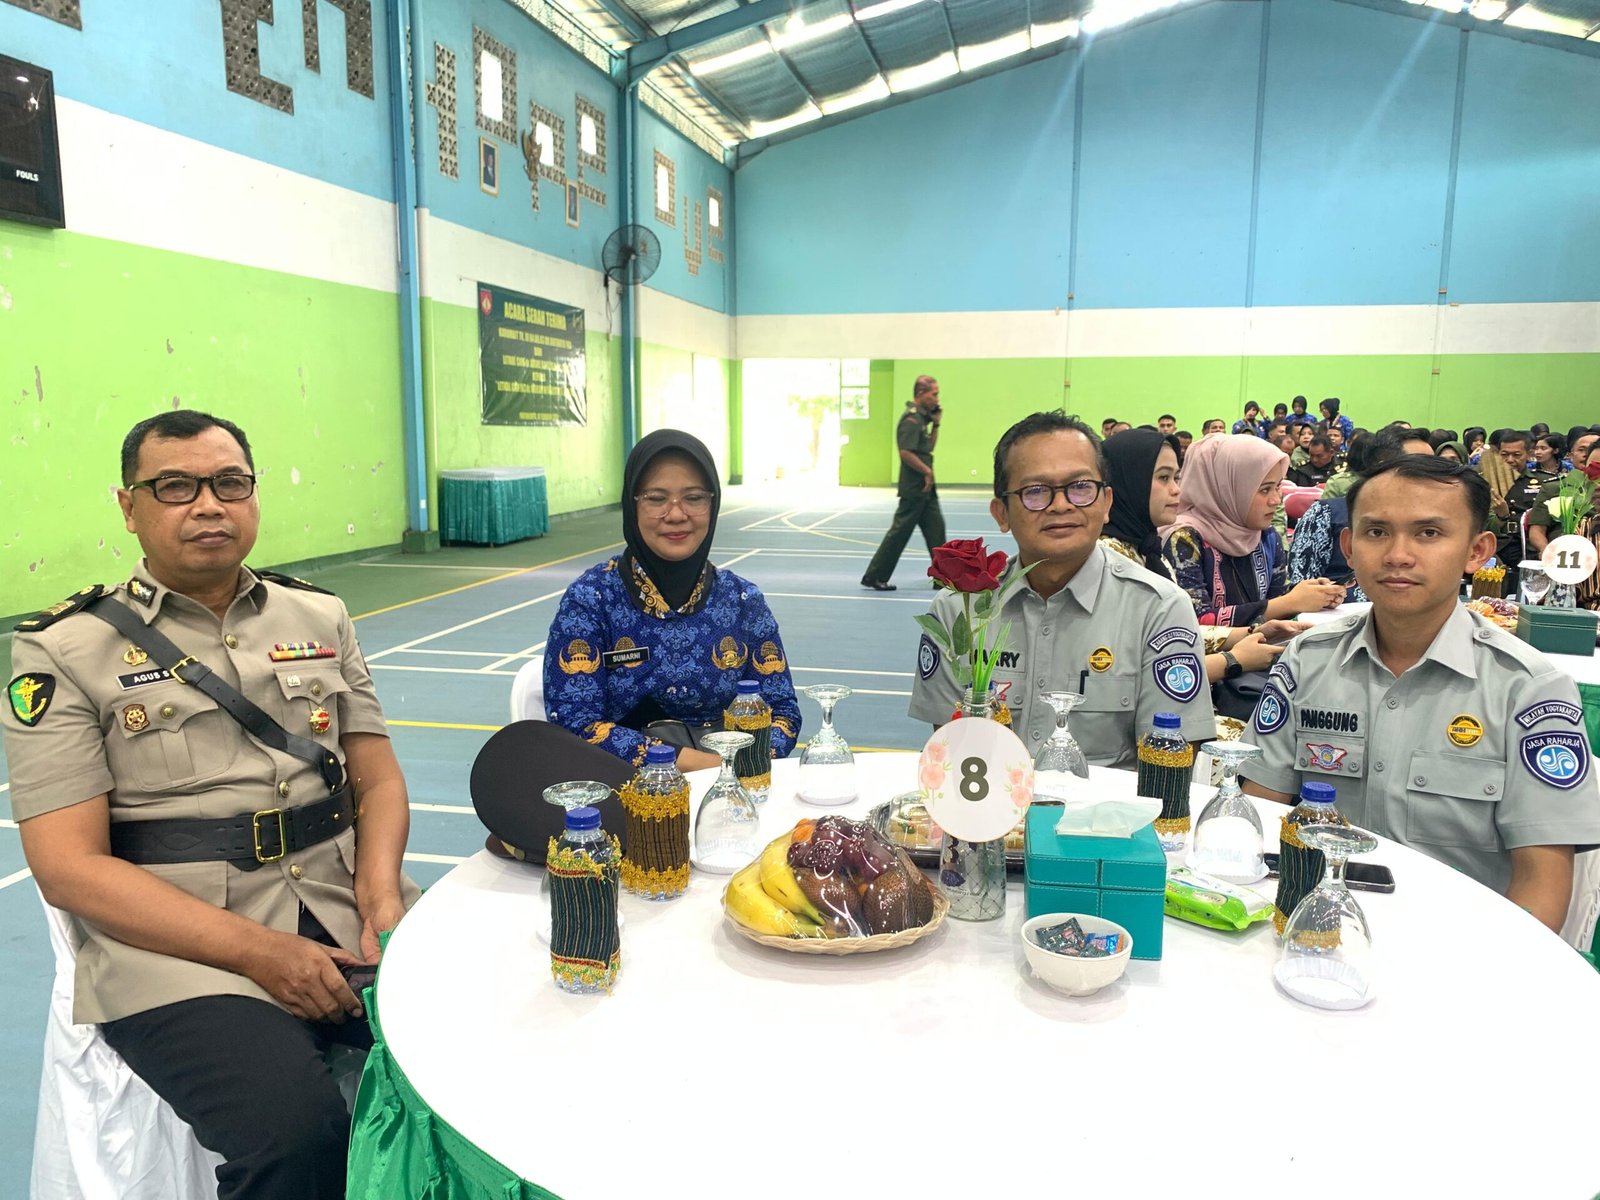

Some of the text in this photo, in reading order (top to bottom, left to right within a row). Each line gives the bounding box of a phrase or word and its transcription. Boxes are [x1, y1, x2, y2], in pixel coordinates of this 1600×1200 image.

[16, 169, 39, 182] FOULS
[504, 301, 526, 322] ACARA
[1557, 551, 1581, 569] 11
[612, 652, 641, 662] SUMARNI
[1157, 657, 1195, 671] JASA RAHARJA
[134, 670, 170, 683] AGUS S
[1300, 709, 1359, 733] PANGGUNG
[1523, 705, 1578, 724] WILAYAH YOGYAKARTA
[1527, 737, 1580, 750] JASA RAHARJA
[959, 756, 990, 802] 8
